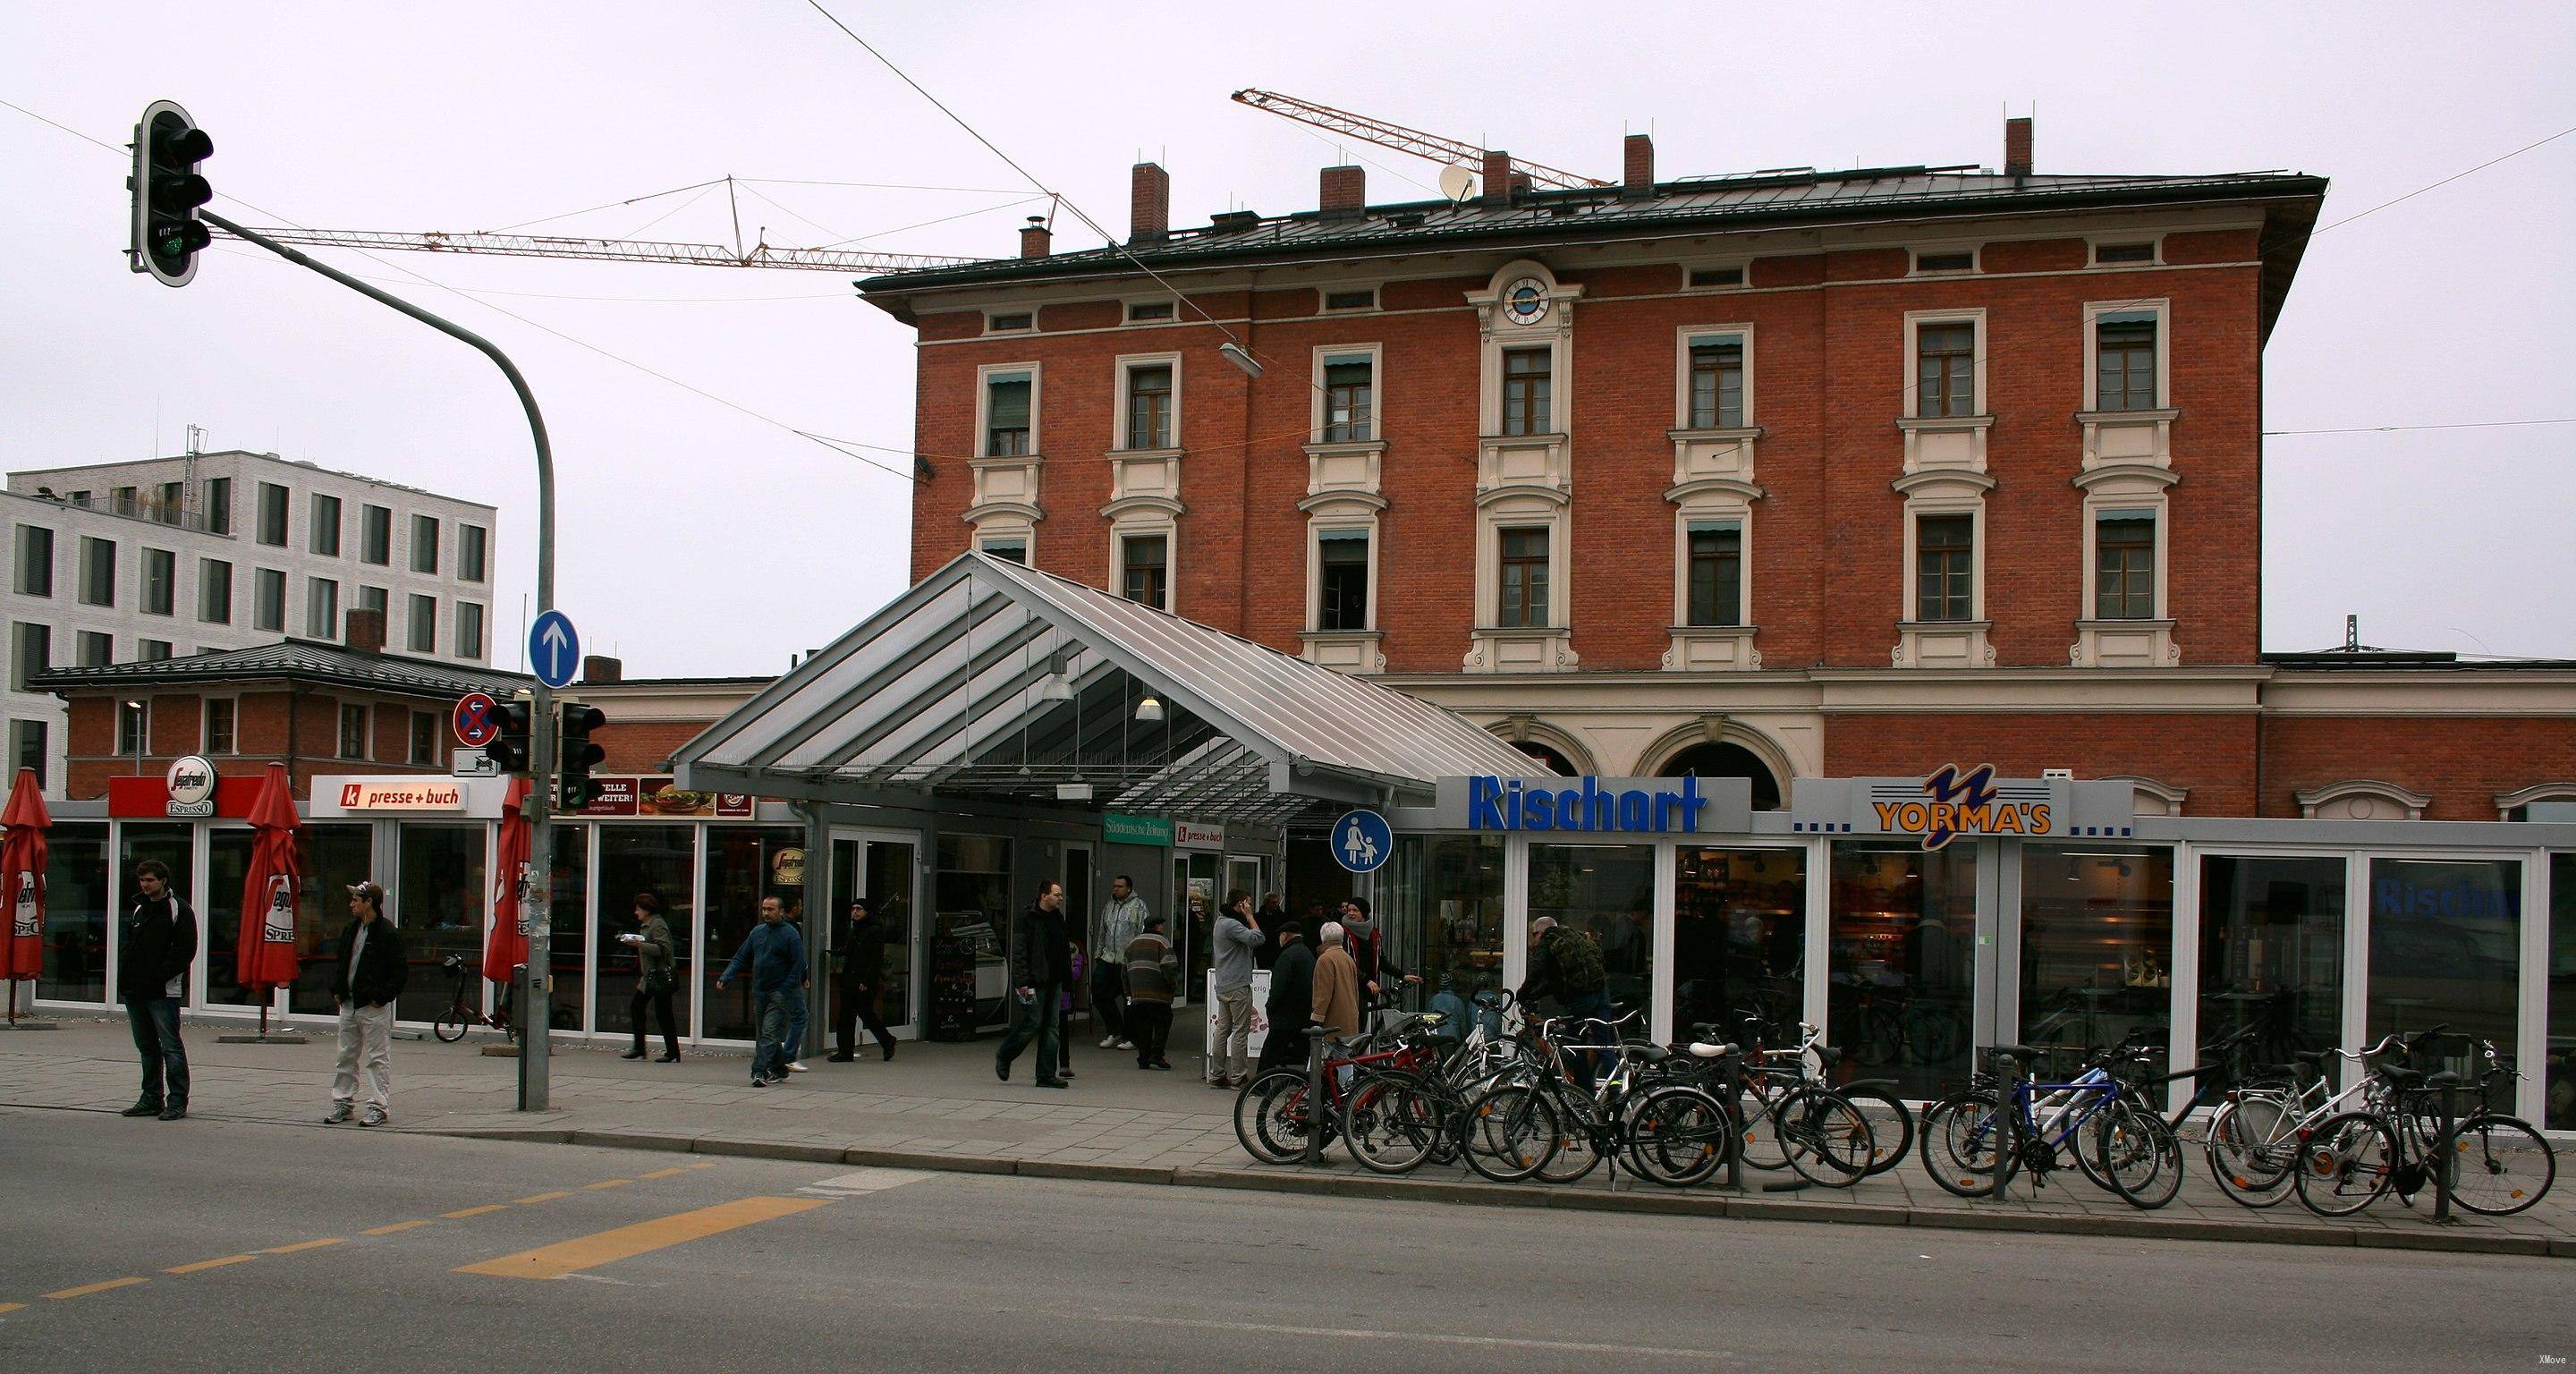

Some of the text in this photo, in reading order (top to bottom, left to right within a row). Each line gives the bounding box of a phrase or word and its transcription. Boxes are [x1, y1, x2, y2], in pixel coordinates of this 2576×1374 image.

[170, 803, 208, 814] ESPRESSO
[369, 793, 413, 808] presse
[415, 793, 424, 803] +
[426, 788, 459, 804] buch
[1468, 775, 1709, 833] Rischart
[1872, 802, 2051, 835] YORMA'S
[1106, 818, 1169, 842] Süddeutsche Zeitung
[1188, 832, 1206, 843] presse
[1210, 831, 1223, 842] buch
